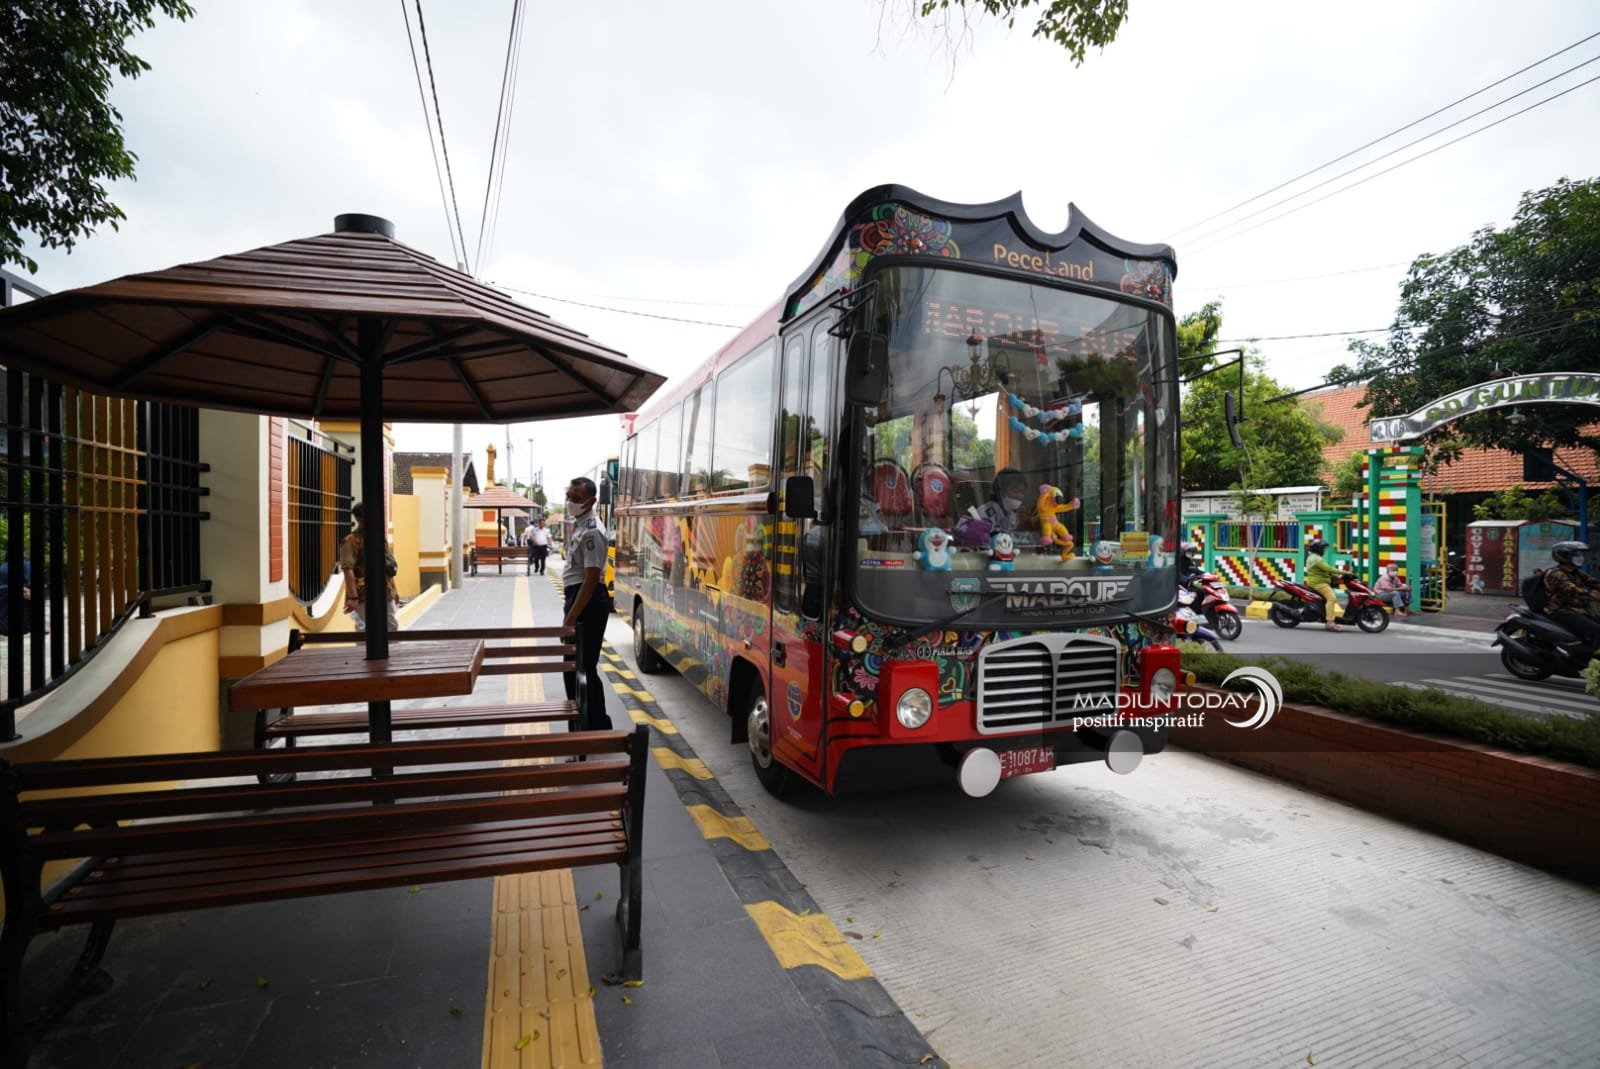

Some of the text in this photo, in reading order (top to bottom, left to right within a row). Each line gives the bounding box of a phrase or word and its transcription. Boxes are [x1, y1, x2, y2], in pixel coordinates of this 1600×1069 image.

[993, 243, 1094, 281] PeceLand
[1471, 377, 1600, 406] GUNTU
[1470, 527, 1483, 563] COVID
[1006, 580, 1119, 609] MABOUR
[1012, 748, 1037, 767] 1087
